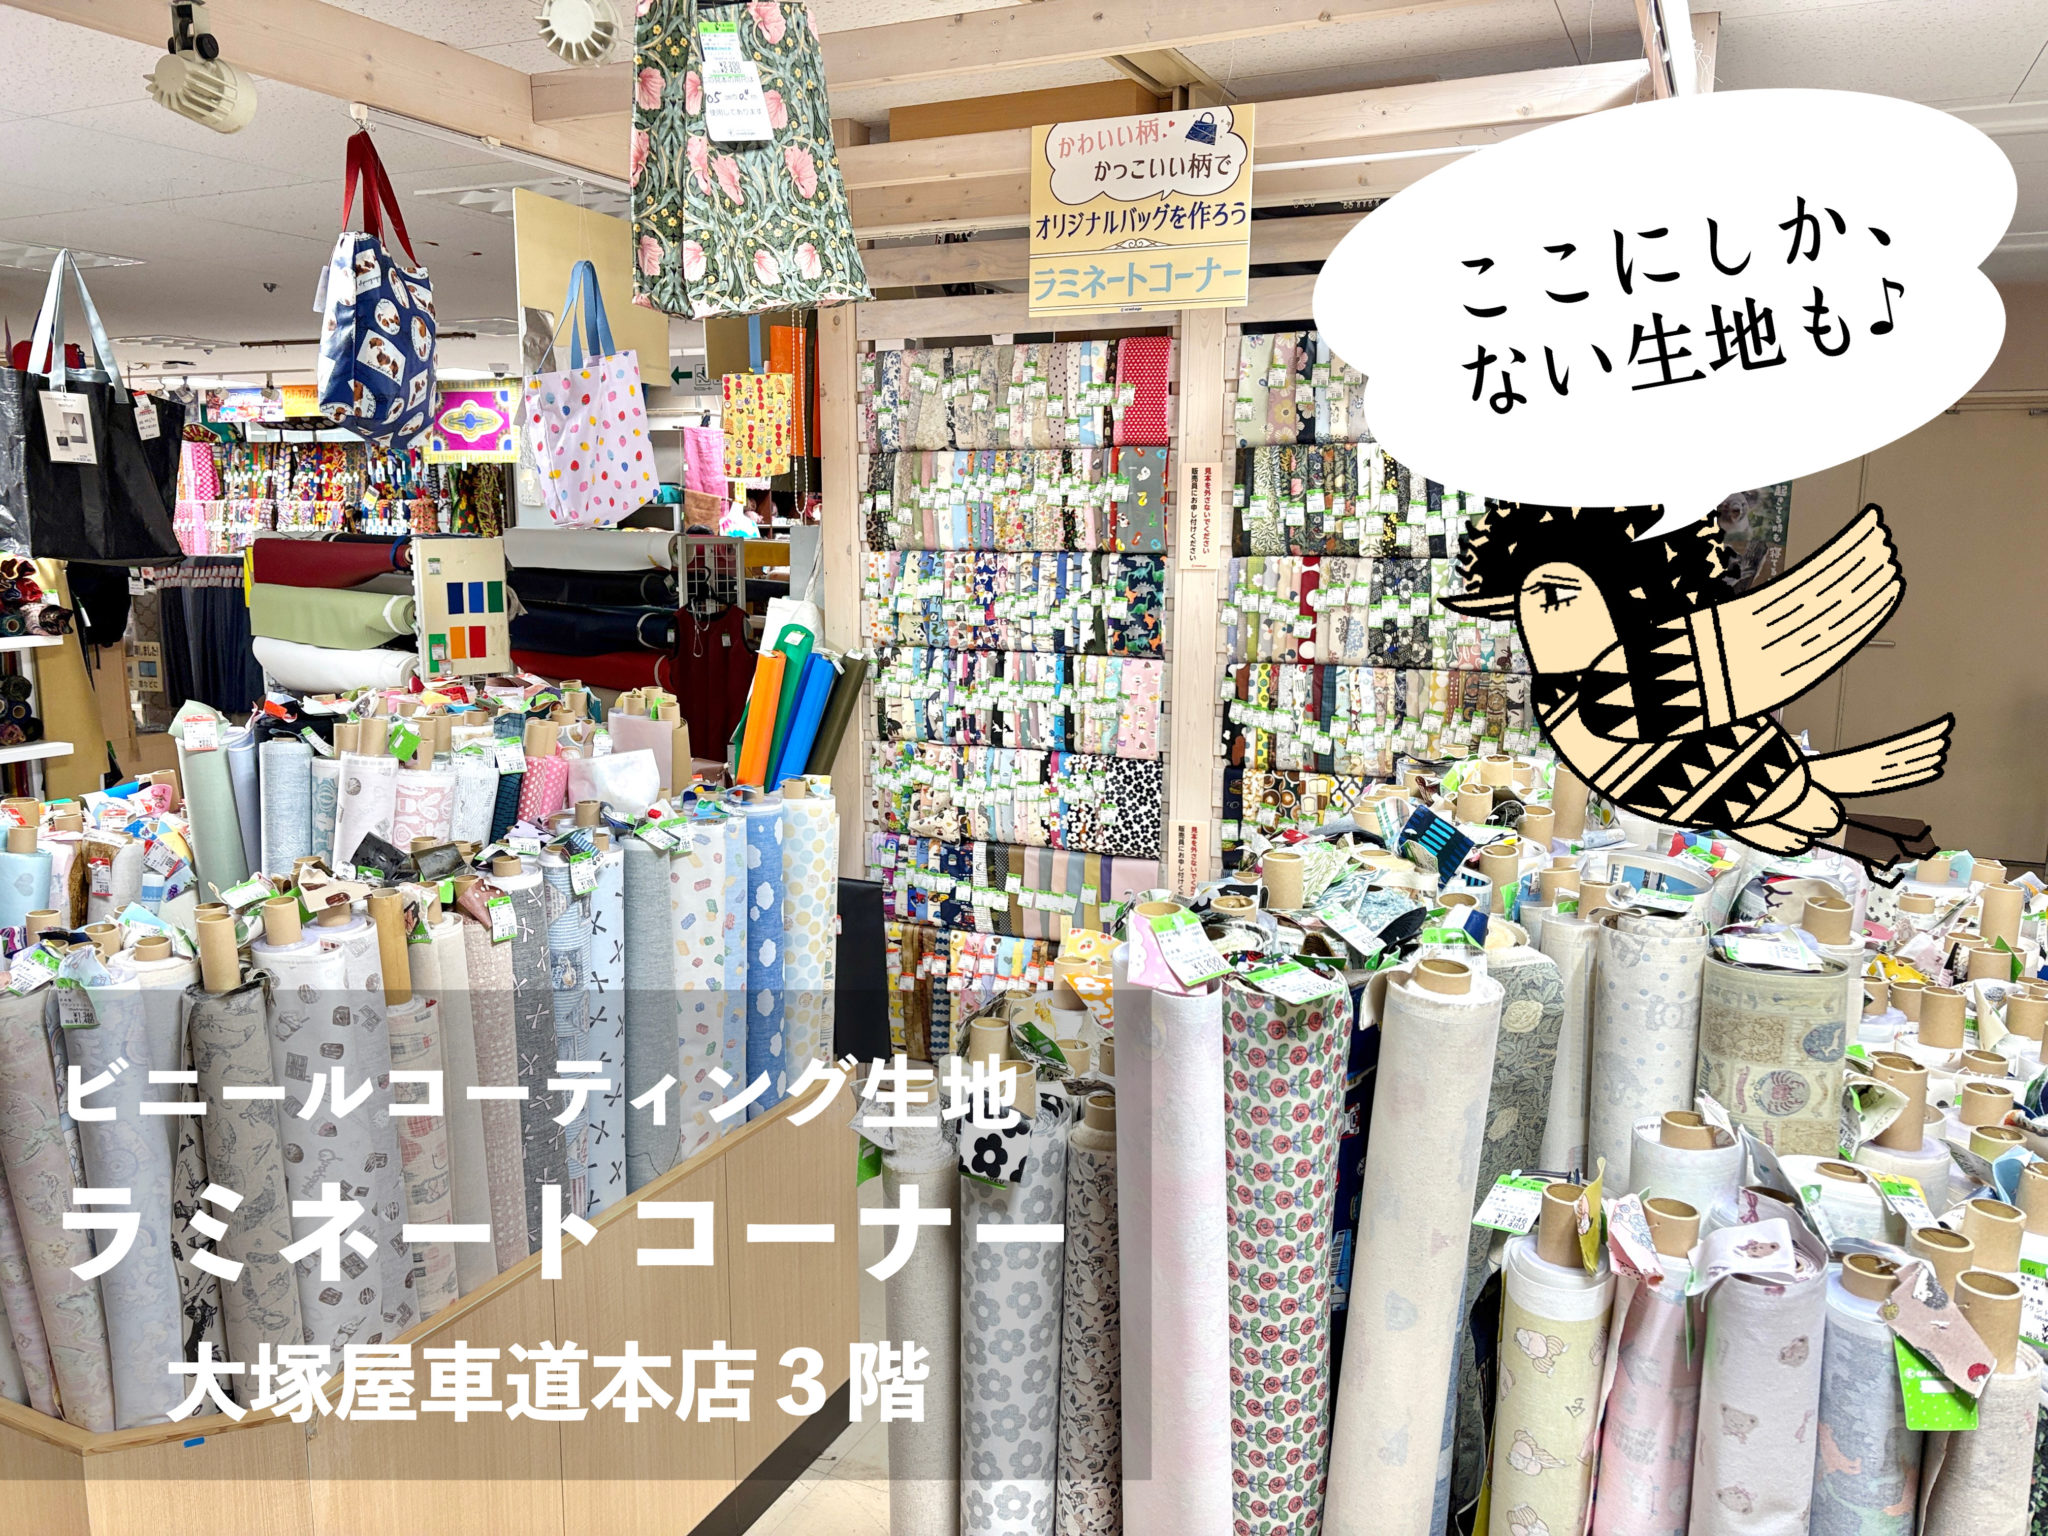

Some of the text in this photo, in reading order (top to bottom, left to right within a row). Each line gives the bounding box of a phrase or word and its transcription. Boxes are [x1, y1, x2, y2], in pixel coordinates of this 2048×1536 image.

[1059, 118, 1159, 158] かわいい柄
[1094, 152, 1232, 182] かっこいい柄で
[1036, 200, 1247, 241] オリジナルバッグを作ろう
[1034, 257, 1244, 302] ラミネートコーナー
[1189, 467, 1199, 561] 販売員にお申し付けください
[1202, 467, 1212, 555] 見本を外さないでください
